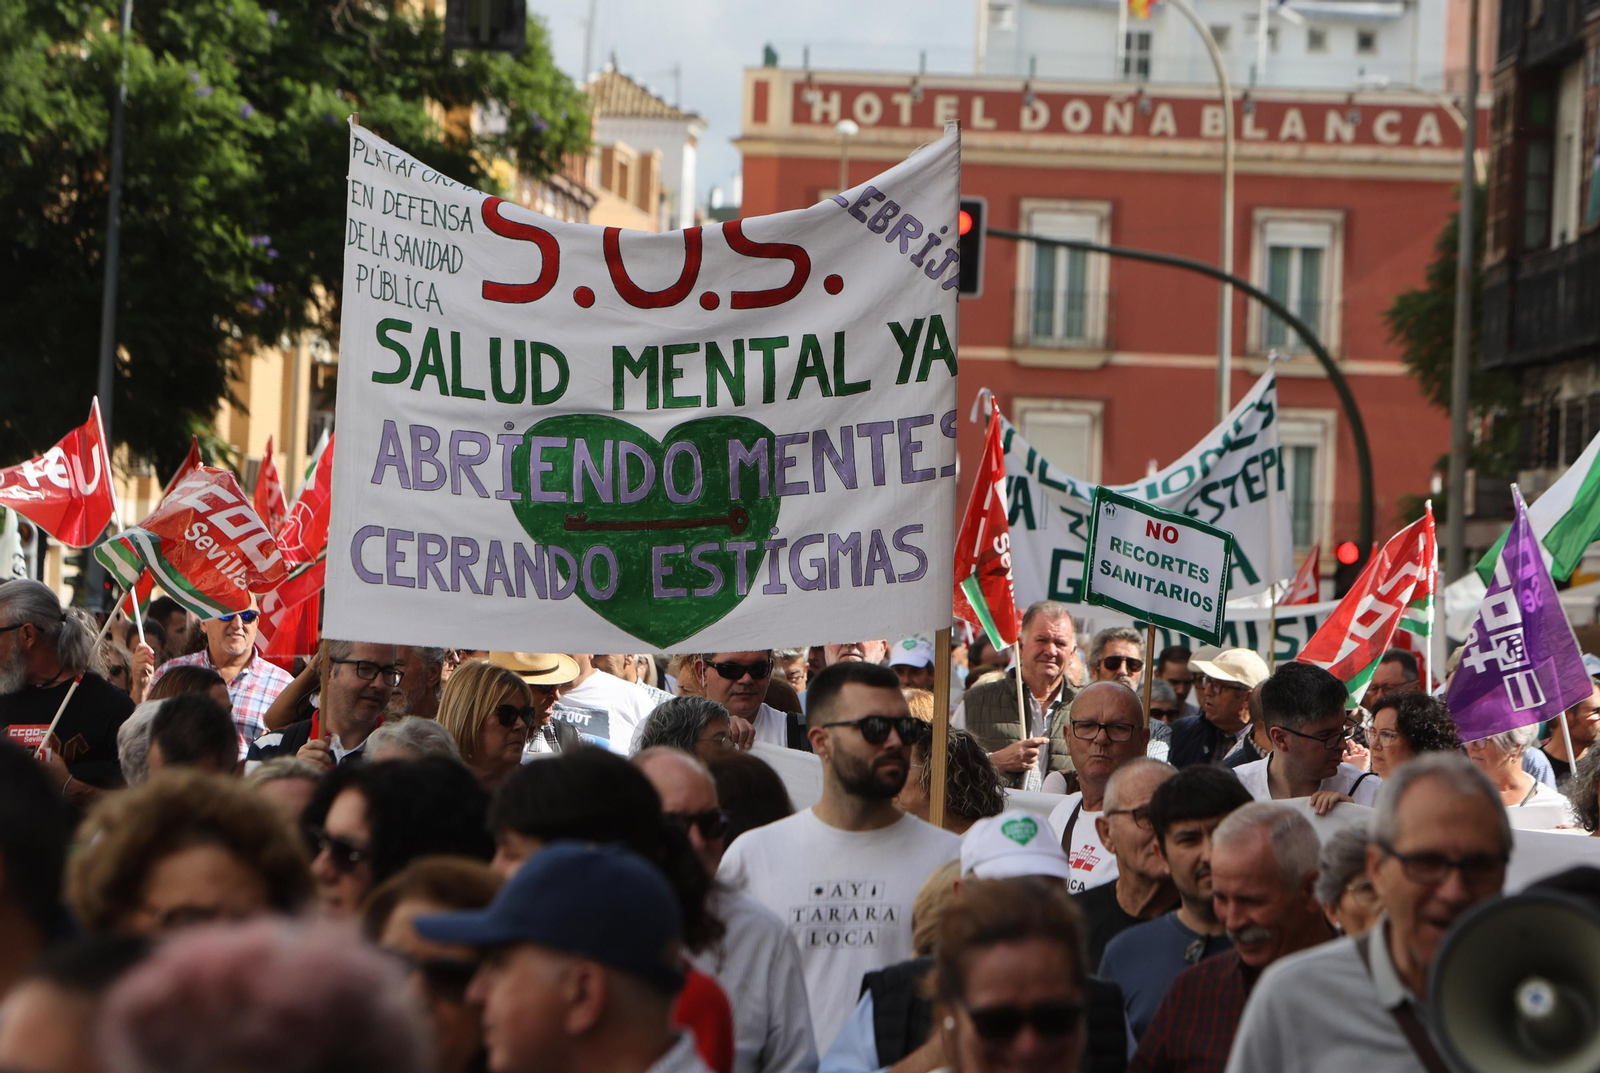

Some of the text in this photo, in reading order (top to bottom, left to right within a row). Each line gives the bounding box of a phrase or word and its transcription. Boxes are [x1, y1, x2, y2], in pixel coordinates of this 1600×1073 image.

[810, 90, 1443, 146] HOTEL DOÑA BLANCA
[351, 180, 474, 234] EN DEFENSA
[393, 233, 464, 275] SANIDAD
[830, 185, 960, 302] EBRIJ
[356, 263, 444, 316] PÚBLICA
[371, 314, 958, 411] SALUD MENTAL YA
[370, 419, 703, 504] ABRIENDO
[184, 522, 248, 591] Sevilla
[1146, 519, 1179, 544] NO
[350, 524, 620, 600] CERRANDO
[652, 523, 929, 598] ESTIGMAS
[1100, 559, 1213, 612] SANITARIOS
[1110, 536, 1209, 584] RECORTES
[9, 728, 41, 737] CCOO
[793, 907, 895, 922] TARARA
[831, 884, 862, 897] AY
[811, 930, 874, 946] LOCA
